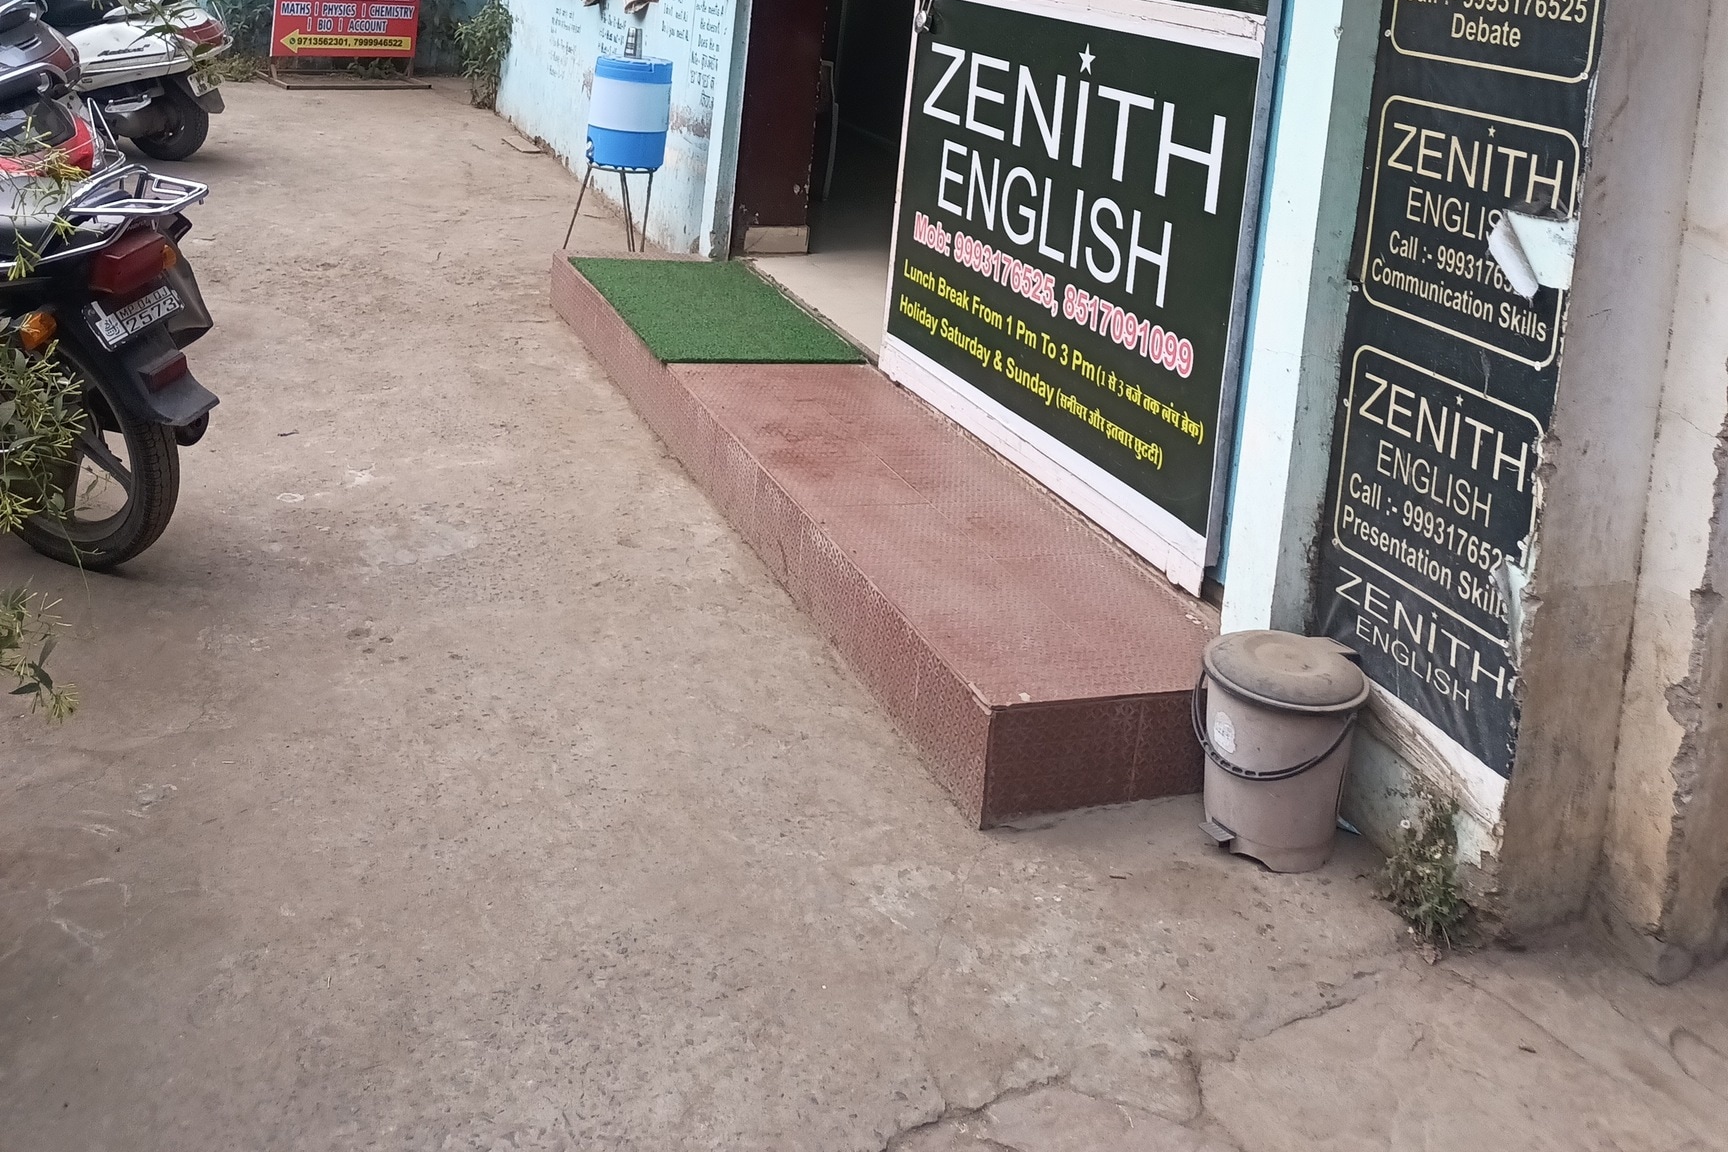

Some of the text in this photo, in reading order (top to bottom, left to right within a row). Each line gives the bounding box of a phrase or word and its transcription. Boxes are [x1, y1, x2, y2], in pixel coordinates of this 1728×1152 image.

[281, 2, 311, 16] MATHS
[322, 3, 356, 17] PHYSICS
[369, 5, 415, 19] CHEMISTRY
[297, 36, 403, 47] 9713562301, 7999946522
[317, 18, 333, 32] BIO
[348, 19, 387, 33] ACCOUNT
[1451, 12, 1521, 48] Debate
[922, 42, 1226, 214] ZENITH
[1387, 122, 1563, 209] ZENITH
[937, 139, 1173, 308] ENGLISH
[1406, 186, 1504, 242] ENGLIS
[913, 211, 1194, 378] Mob: 9993176525, 8517091099
[1372, 258, 1547, 343] Communication Skills
[1389, 230, 1418, 261] Call
[1437, 245, 1520, 295] 9993176
[119, 305, 134, 319] MP
[137, 297, 152, 309] 04
[126, 297, 177, 333] 2573
[904, 258, 935, 288] Lunch
[938, 276, 970, 311] Break
[972, 295, 1003, 330] From
[1006, 315, 1012, 336] 1
[1016, 320, 1037, 349] Pm
[1041, 333, 1057, 359] To
[1060, 344, 1068, 366] 3
[1107, 371, 1118, 393] से
[1125, 384, 1142, 407] बजे
[1143, 393, 1161, 415] तक
[1161, 402, 1181, 429] लंच
[900, 294, 938, 336] Holiday
[940, 317, 991, 368] Saturday
[993, 350, 1003, 372] &
[1006, 357, 1055, 407] Sunday
[1088, 408, 1105, 433] और
[1105, 420, 1134, 449] इतवार
[1359, 372, 1528, 492] ZENITH
[1350, 473, 1381, 510] Call
[1403, 500, 1512, 575] 999317652
[1377, 439, 1492, 528] ENGLISH
[1343, 504, 1451, 589] Presentation
[1335, 566, 1505, 699] ZENITH
[1356, 615, 1470, 711] ENGLISH
